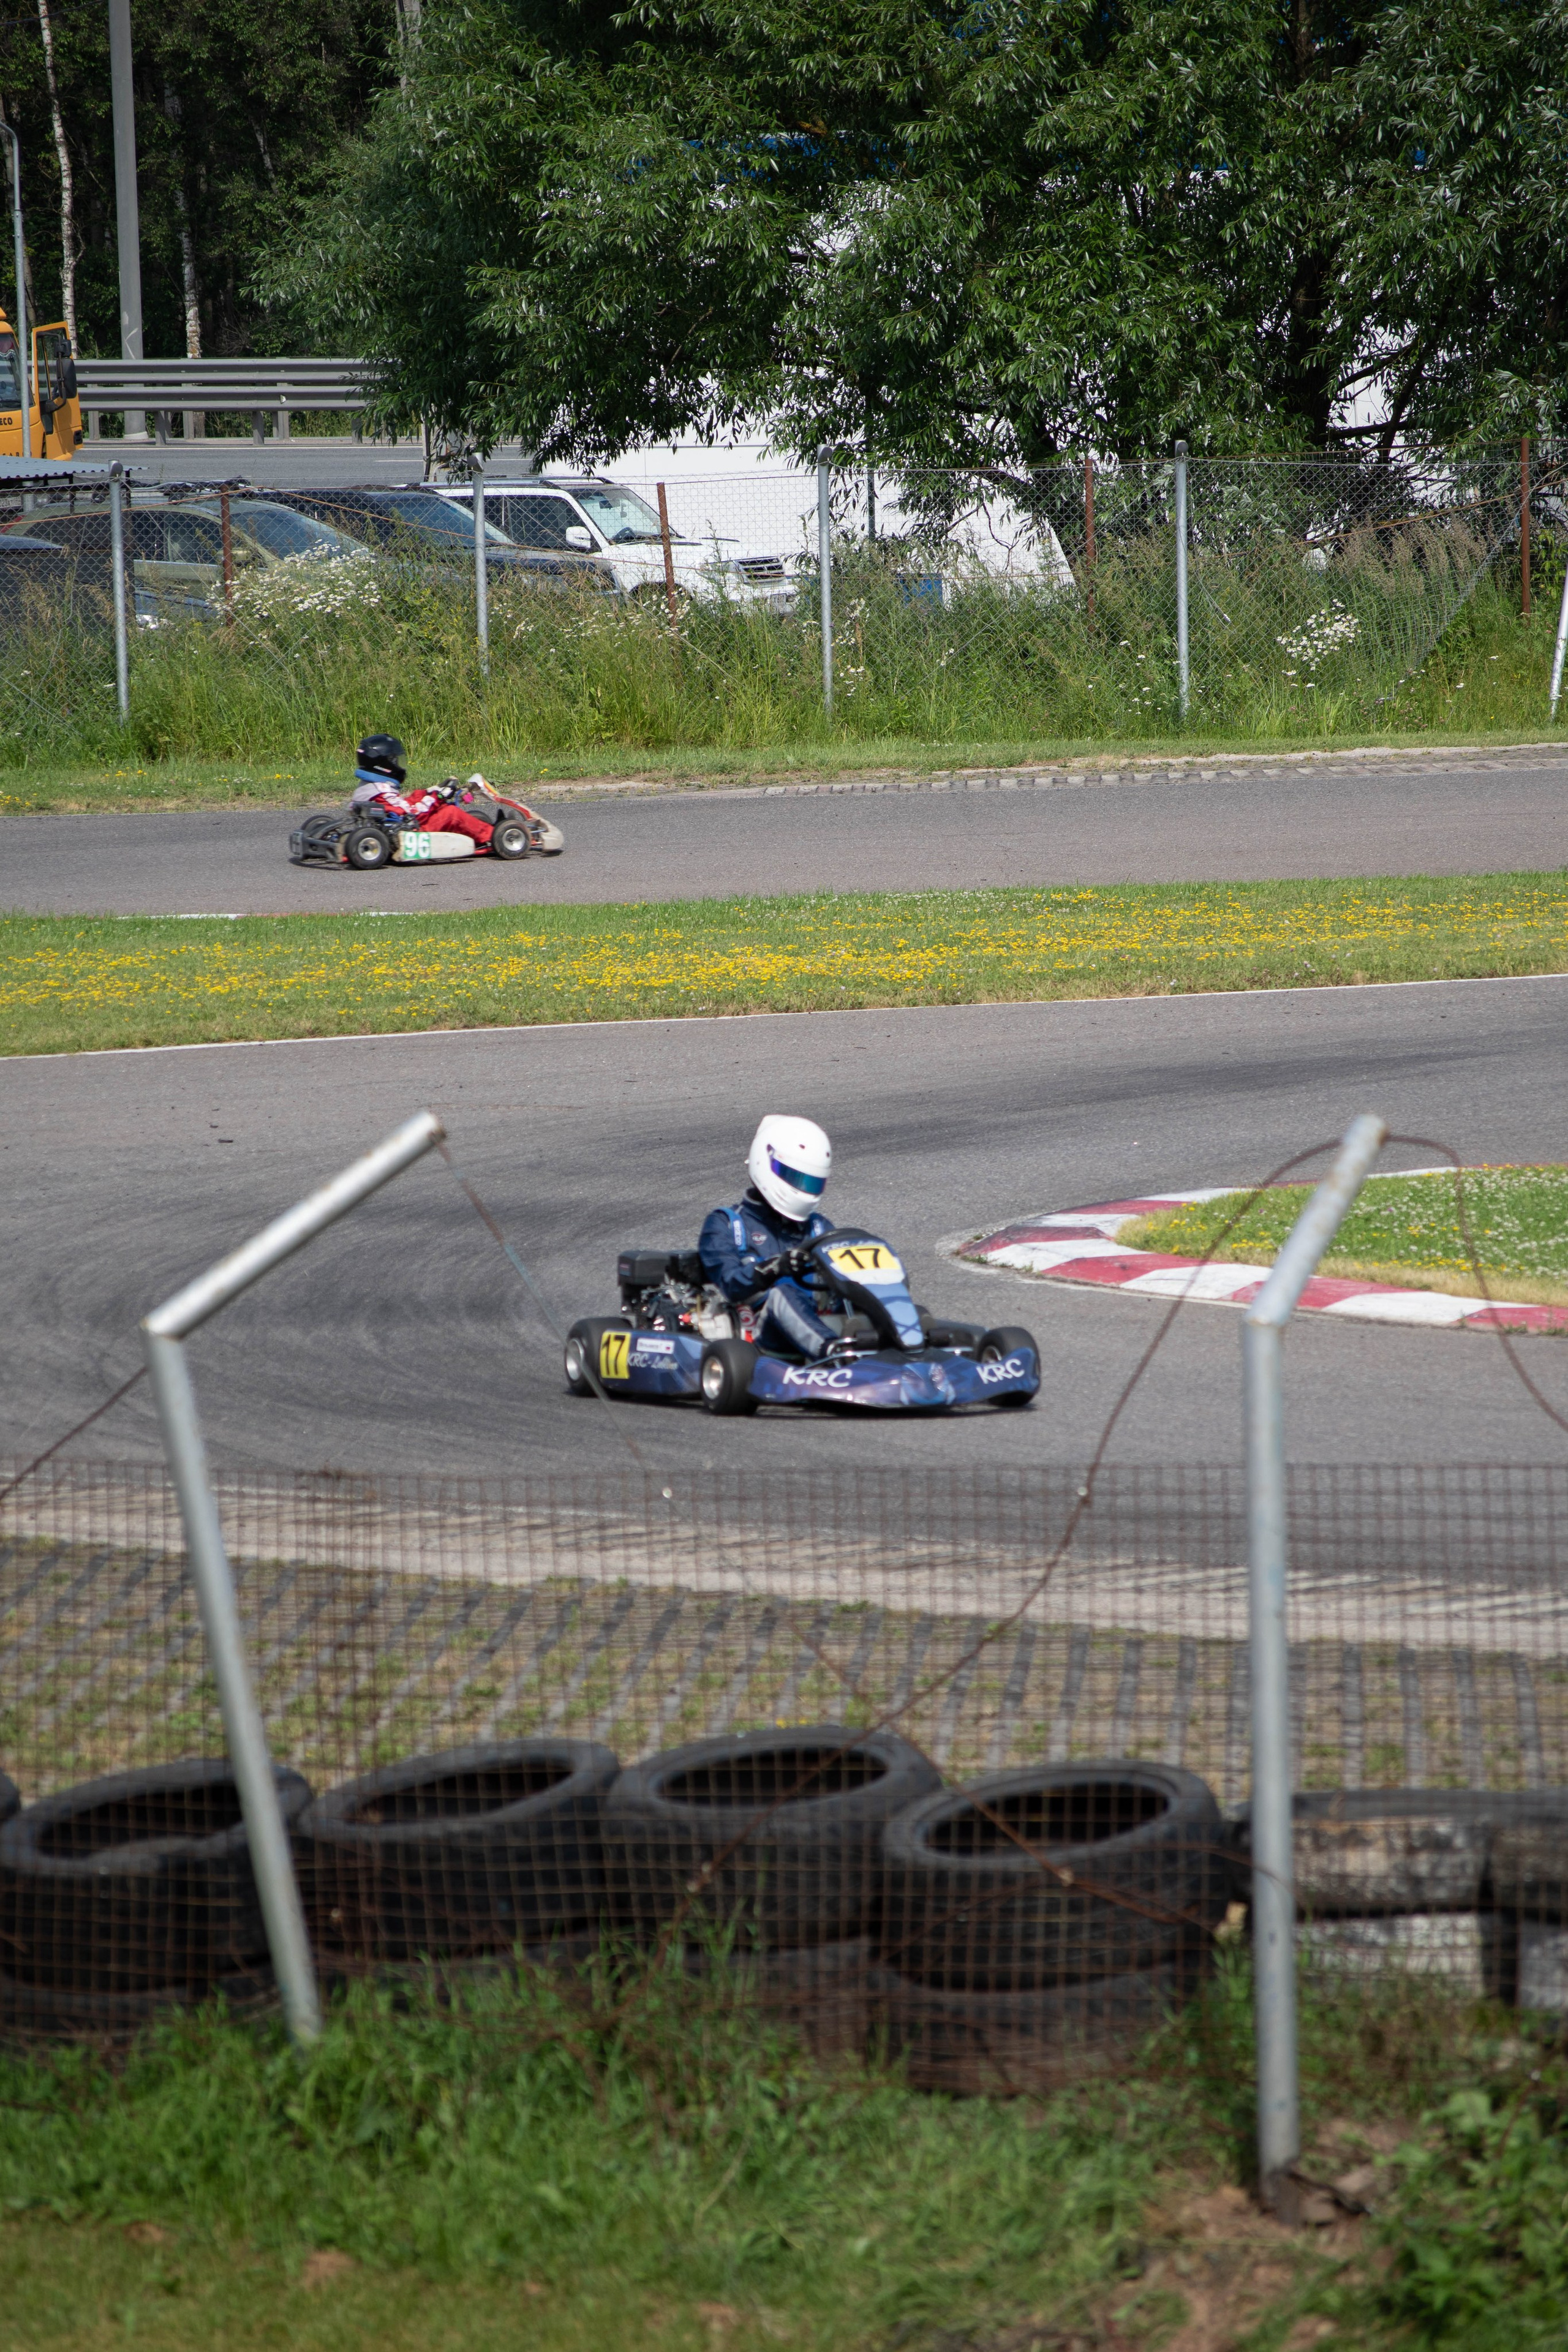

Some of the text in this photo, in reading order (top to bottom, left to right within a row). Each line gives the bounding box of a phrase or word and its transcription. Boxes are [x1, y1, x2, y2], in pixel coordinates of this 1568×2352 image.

[404, 832, 430, 858] 96
[839, 1248, 881, 1269] 17
[601, 1334, 627, 1376] 17
[783, 1366, 853, 1388] KRC
[976, 1358, 1025, 1384] KRC
